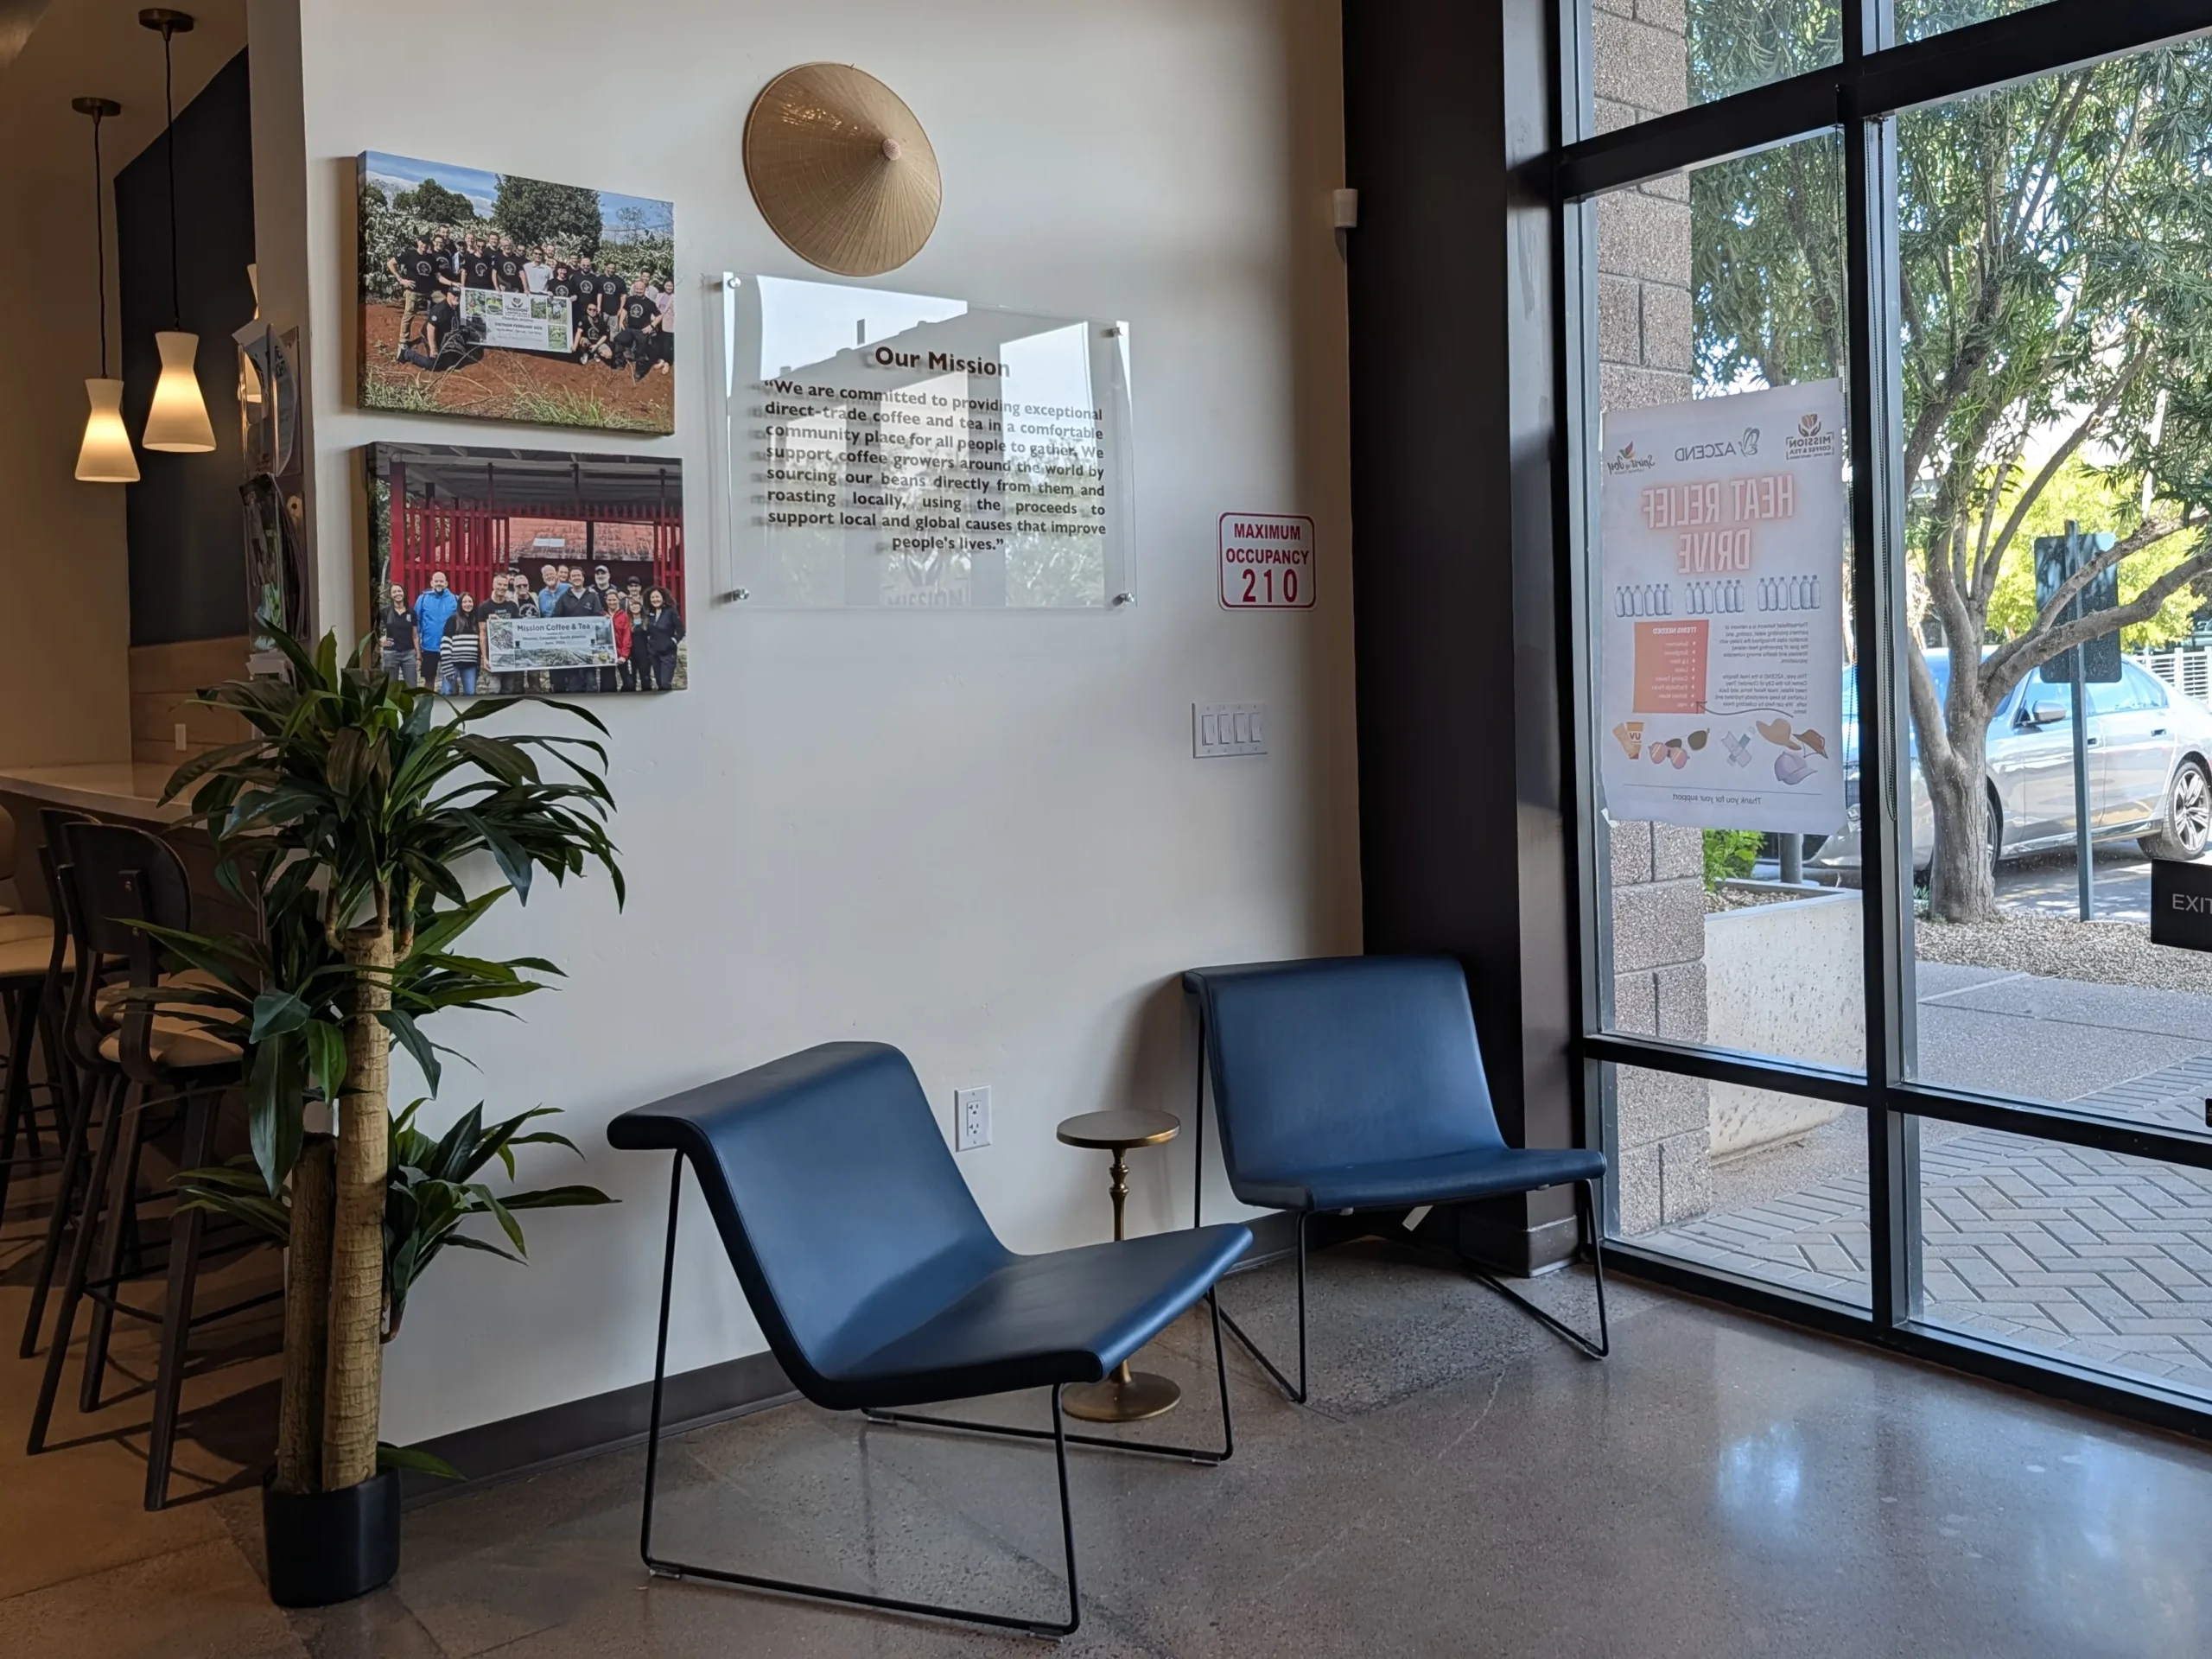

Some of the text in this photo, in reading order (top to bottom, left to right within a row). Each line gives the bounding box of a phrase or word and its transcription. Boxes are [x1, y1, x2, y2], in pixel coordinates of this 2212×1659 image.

[875, 346, 1010, 378] Our Mission
[808, 385, 835, 397] are
[840, 388, 926, 405] committed
[931, 394, 948, 407] to
[952, 397, 1020, 416] providing
[1024, 404, 1102, 421] exceptional
[765, 401, 1103, 440] direct-trade coffee and tea in a comfortable
[766, 425, 860, 445] community
[865, 430, 906, 446] place
[909, 433, 932, 446] for
[936, 435, 953, 448] all
[957, 439, 1006, 454] people
[1011, 441, 1026, 454] to
[1081, 445, 1104, 459] We
[766, 447, 1104, 481] support coffee growers around the world by
[766, 468, 1105, 497] sourcing our beans directly from them and
[767, 490, 1106, 516] roasting locally, using the proceeds to
[768, 512, 1106, 537] support local and global causes that improve
[1234, 523, 1301, 540] MAXIMUM
[893, 536, 956, 552] people's
[1226, 548, 1310, 564] OCCUPANCY
[1243, 569, 1298, 603] 210
[2172, 893, 2212, 915] EXIT
